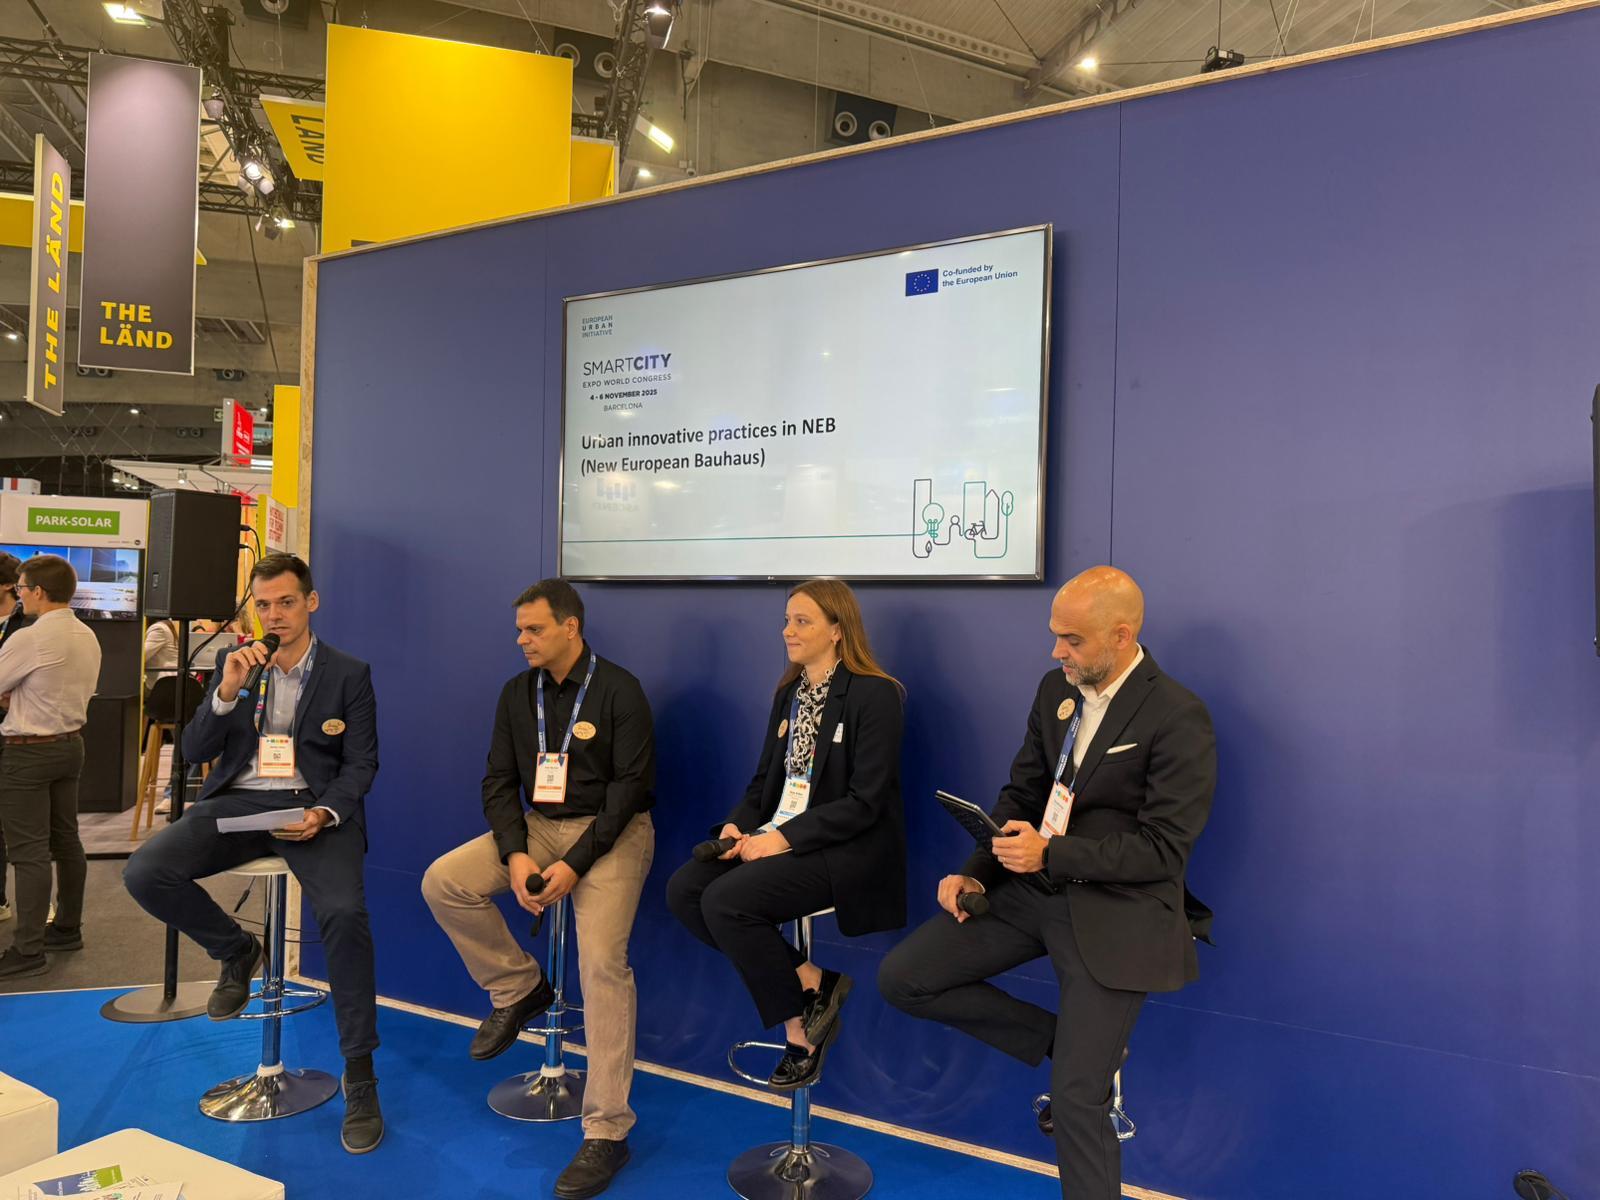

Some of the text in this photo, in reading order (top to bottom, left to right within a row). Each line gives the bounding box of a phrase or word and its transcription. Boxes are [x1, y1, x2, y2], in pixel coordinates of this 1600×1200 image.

[942, 263, 994, 277] Co-funded by
[44, 172, 64, 389] THE LÄND
[955, 274, 993, 286] European
[994, 270, 1018, 280] Union
[100, 301, 152, 323] THE
[582, 315, 613, 324] EUROPEAN
[582, 322, 613, 331] URBAN
[582, 329, 613, 338] INITIATIVE
[100, 323, 173, 349] LÄND
[582, 373, 672, 389] EXPO WORLD CONGRESS
[604, 390, 641, 399] NOVEMBER
[603, 402, 643, 412] BARCELONA
[581, 417, 836, 450] Urban innovative practices in NEB
[581, 448, 766, 477] (New European Bauhaus)
[35, 515, 112, 528] PARK-SOLAR
